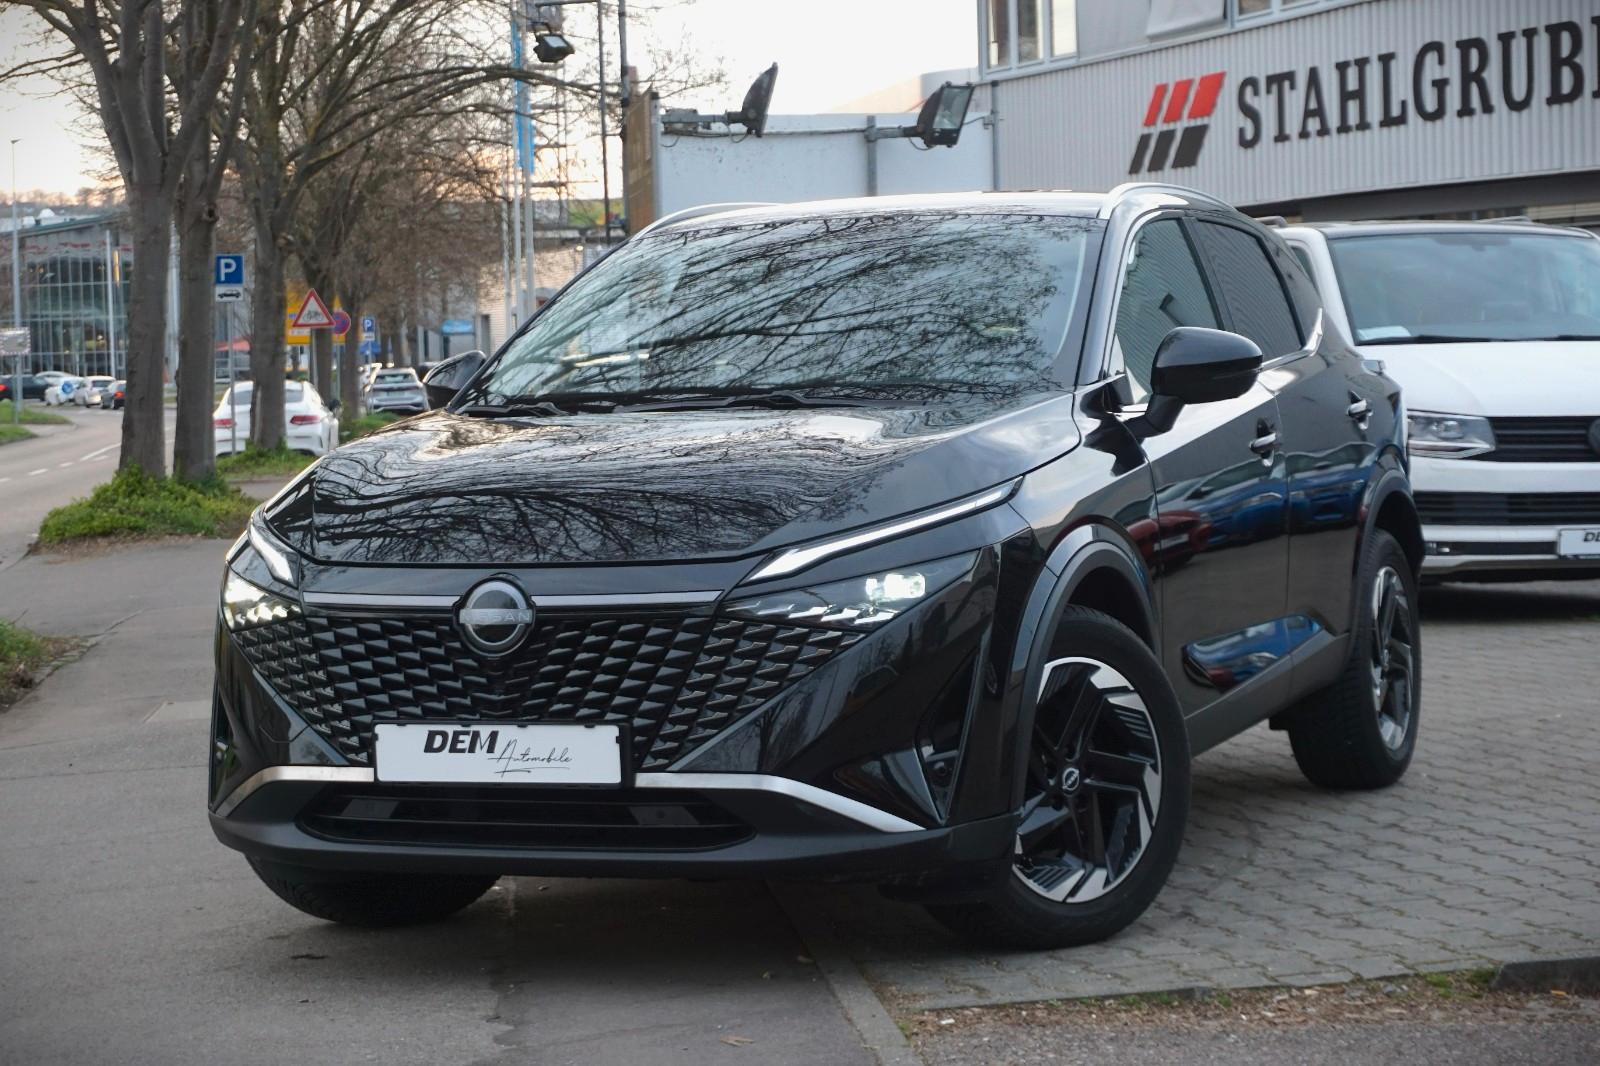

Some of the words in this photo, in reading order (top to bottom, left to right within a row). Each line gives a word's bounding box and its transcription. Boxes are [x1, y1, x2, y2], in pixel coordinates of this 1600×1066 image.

[1238, 16, 1600, 149] STAHLGRUB
[220, 258, 236, 281] P
[424, 730, 499, 754] DEM
[488, 739, 573, 778] Automobile
